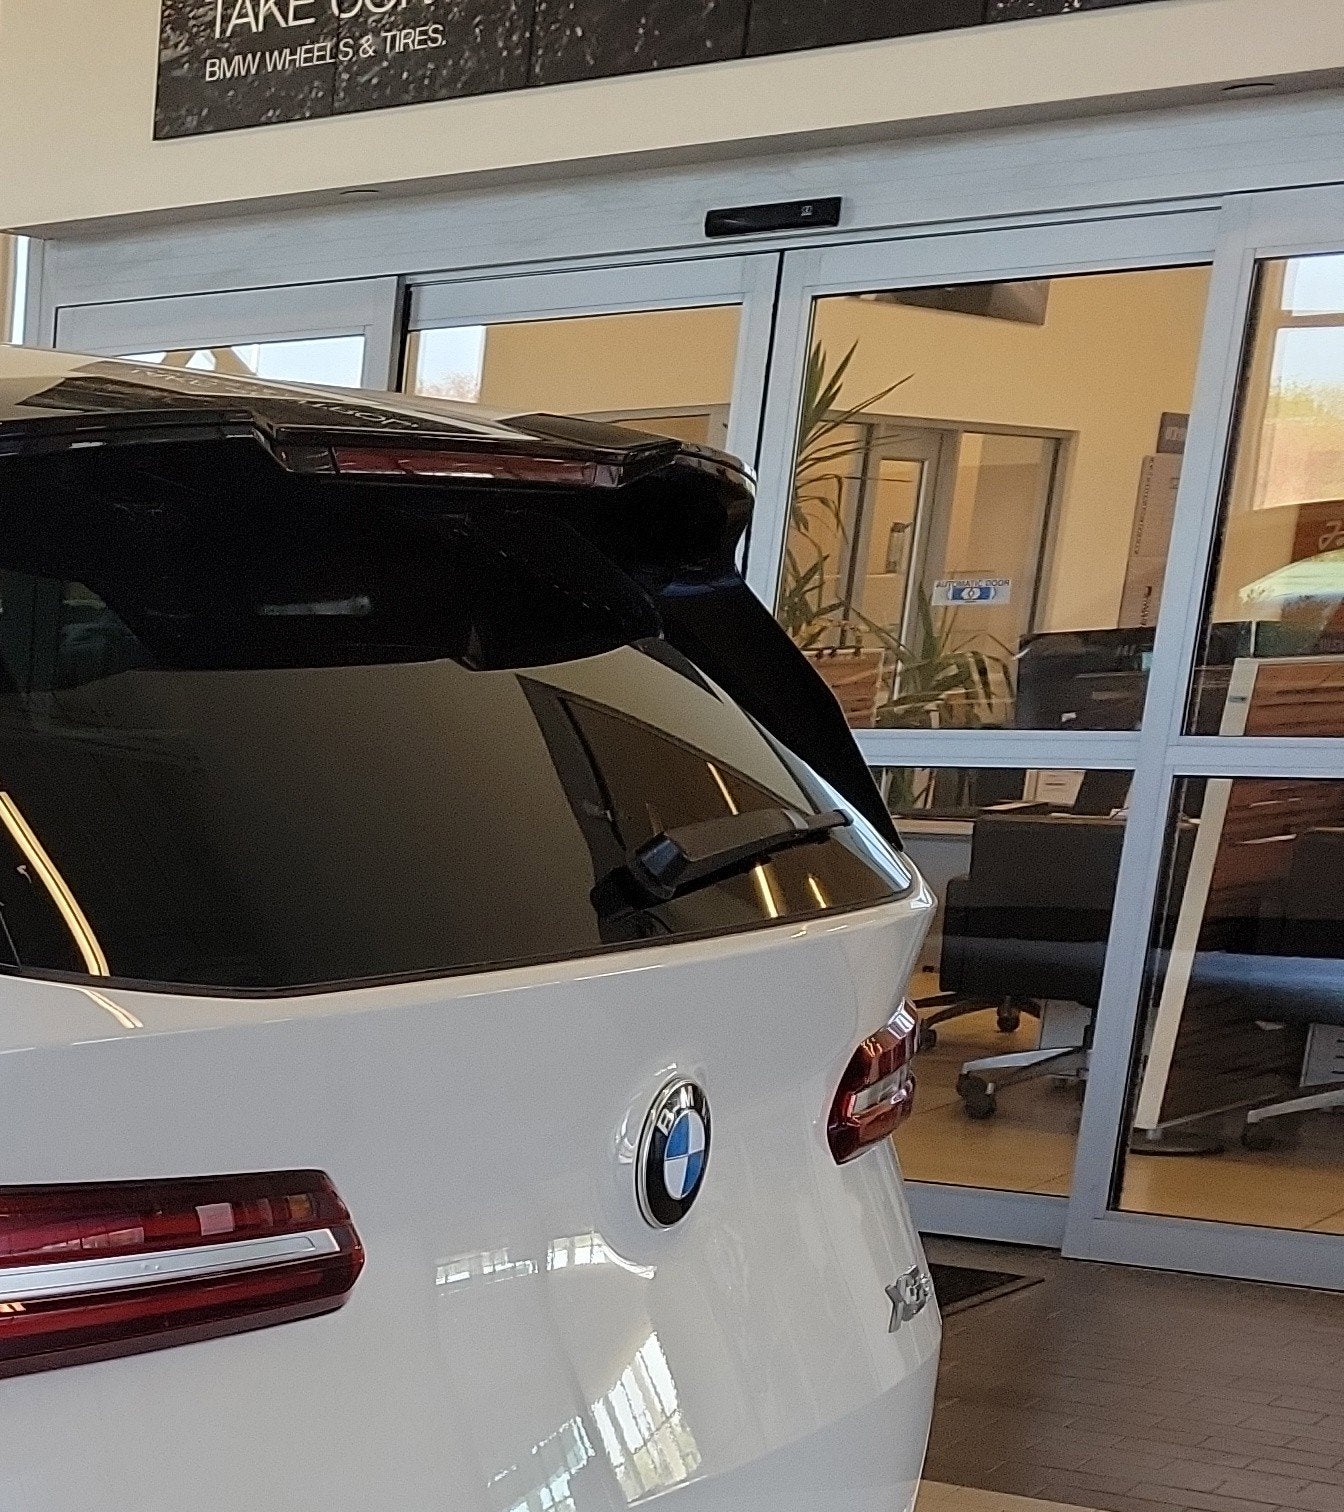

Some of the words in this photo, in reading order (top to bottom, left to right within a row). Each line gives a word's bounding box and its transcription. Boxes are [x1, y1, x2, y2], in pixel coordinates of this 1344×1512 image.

[205, 51, 261, 82] BMW
[265, 39, 355, 72] WHEELS
[358, 34, 376, 58] &
[381, 24, 448, 54] TIRES.
